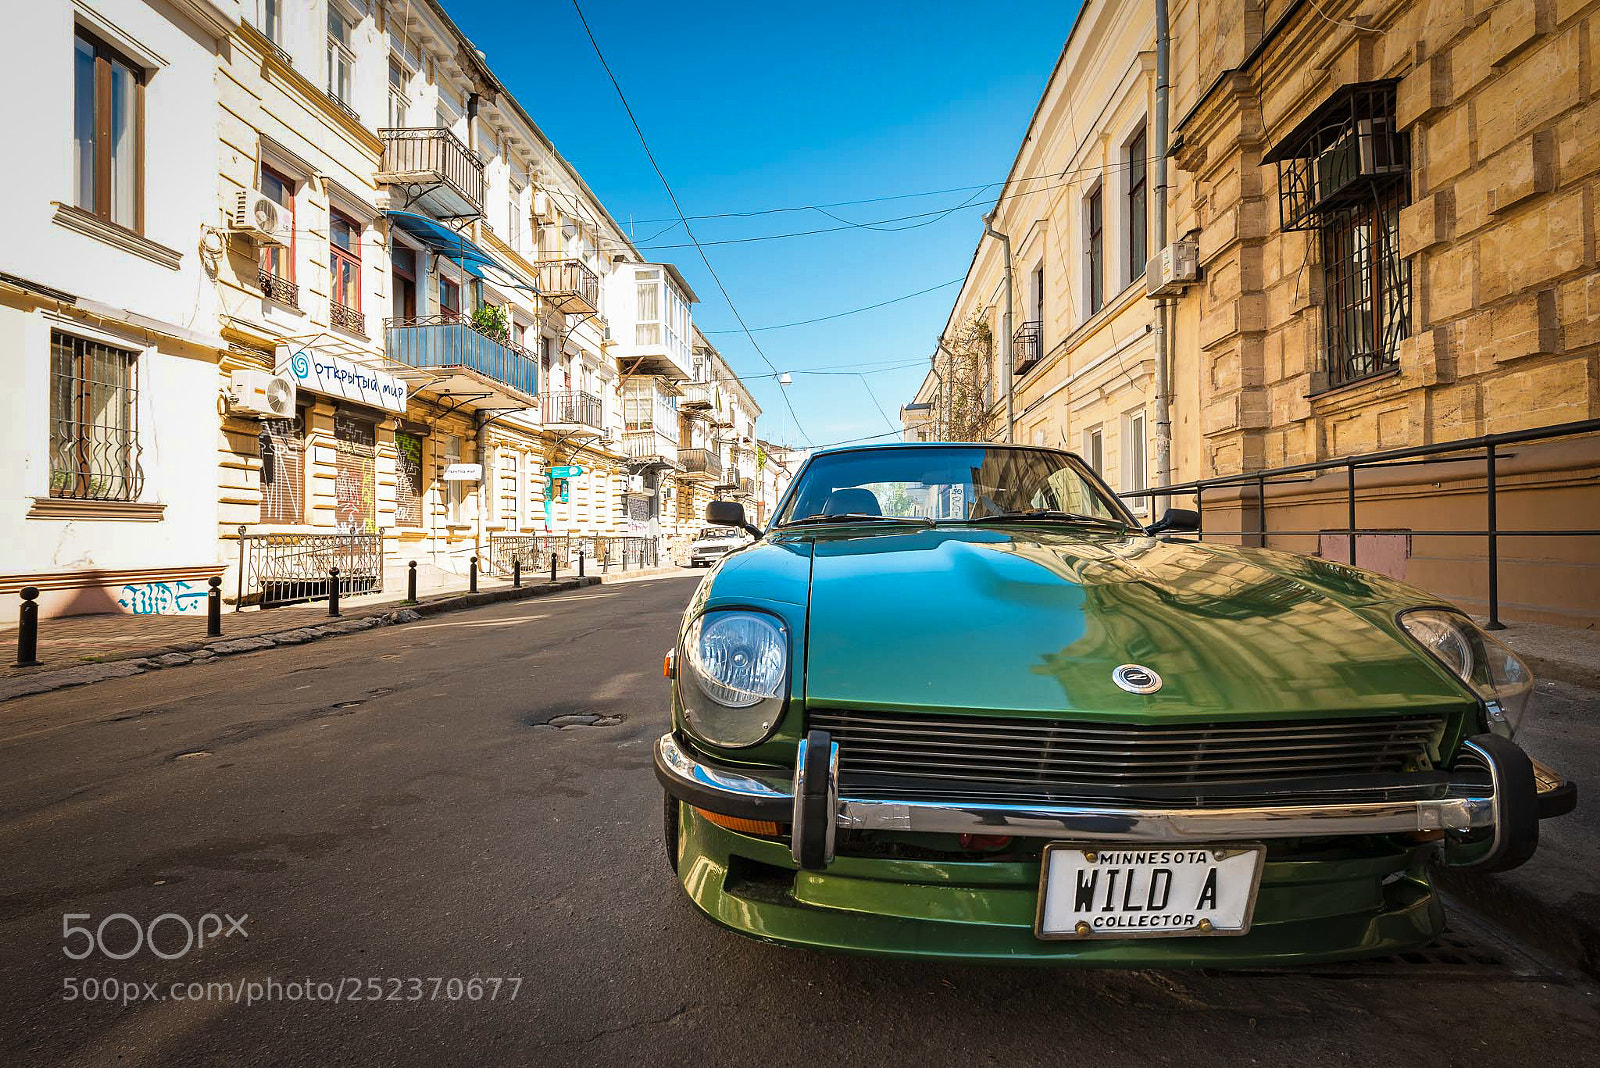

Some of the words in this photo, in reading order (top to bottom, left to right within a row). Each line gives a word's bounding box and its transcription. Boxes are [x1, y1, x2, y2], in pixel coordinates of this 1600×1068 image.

[382, 384, 404, 399] мир
[1099, 851, 1207, 865] MINNESOTA
[1073, 867, 1173, 912] WILD
[1195, 867, 1217, 910] A
[1093, 914, 1195, 928] COLLECTOR
